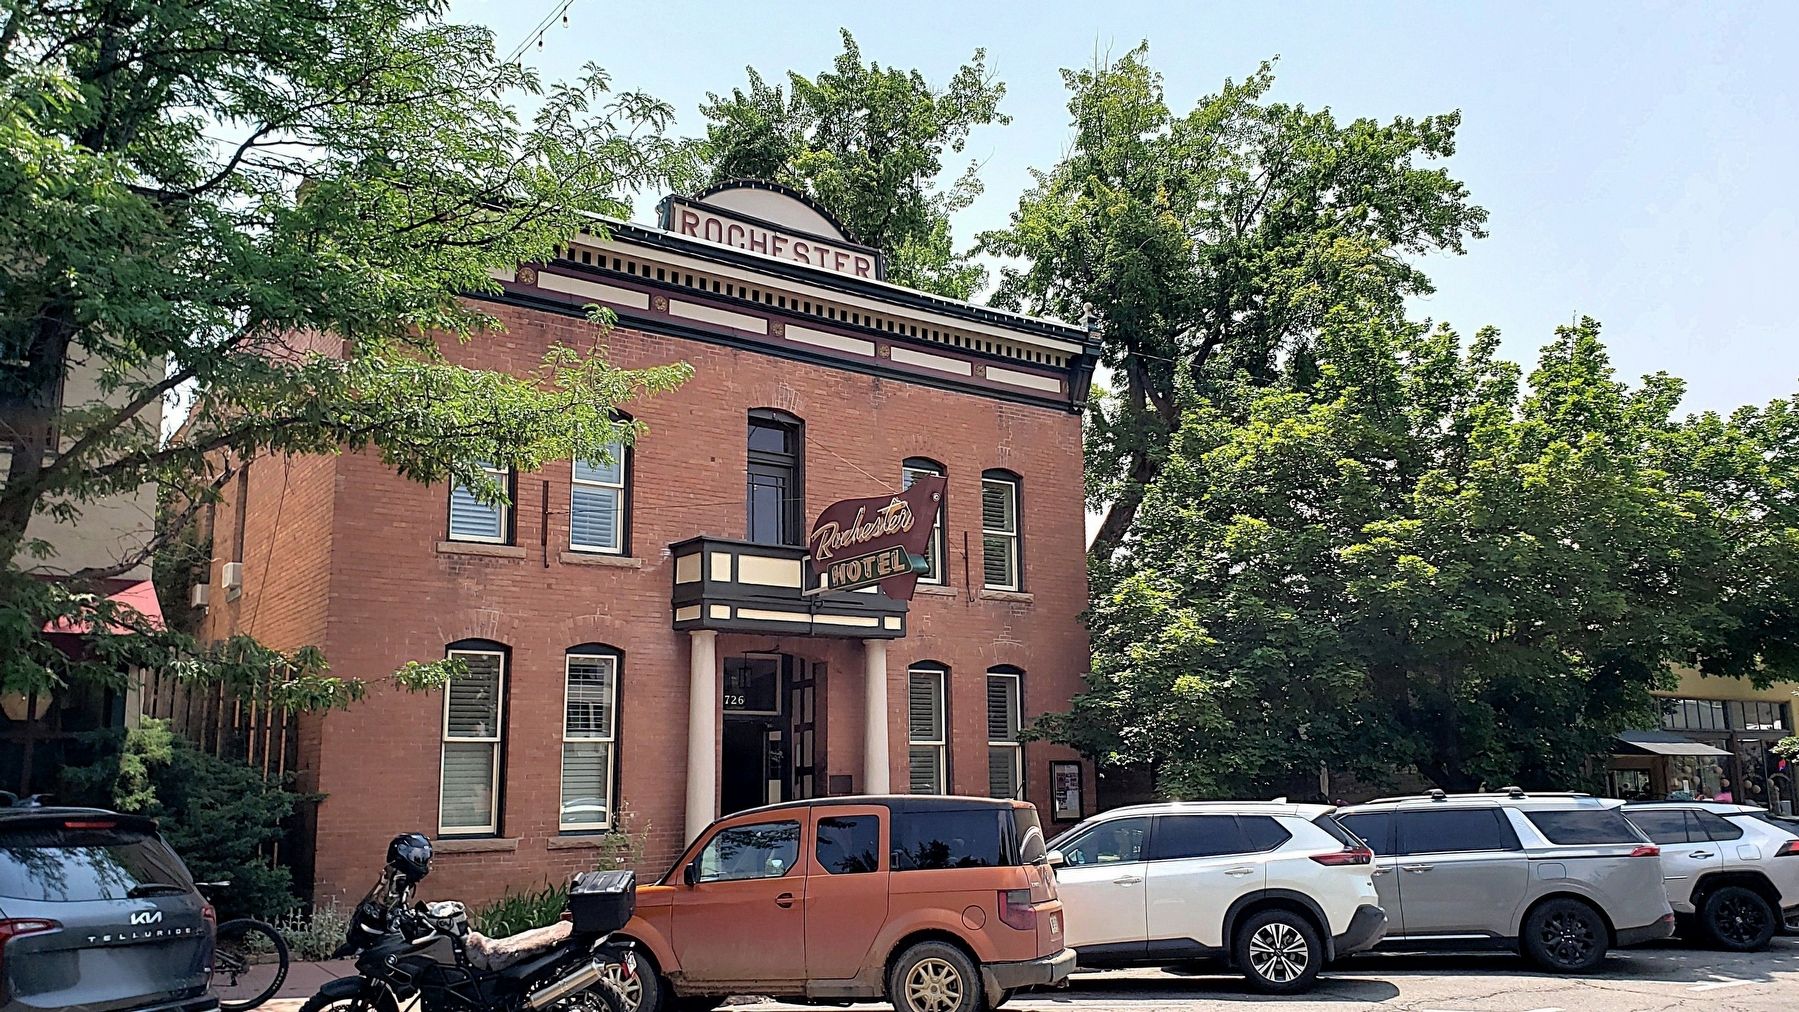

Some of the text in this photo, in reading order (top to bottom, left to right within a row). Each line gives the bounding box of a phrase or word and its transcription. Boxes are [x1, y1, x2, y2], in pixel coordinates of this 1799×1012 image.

[682, 209, 871, 278] ROCHESTER
[811, 497, 915, 562] Rochester
[831, 549, 905, 586] HOTEL
[724, 695, 745, 705] 726
[130, 911, 162, 925] KIA
[88, 927, 191, 943] TELLURIDE
